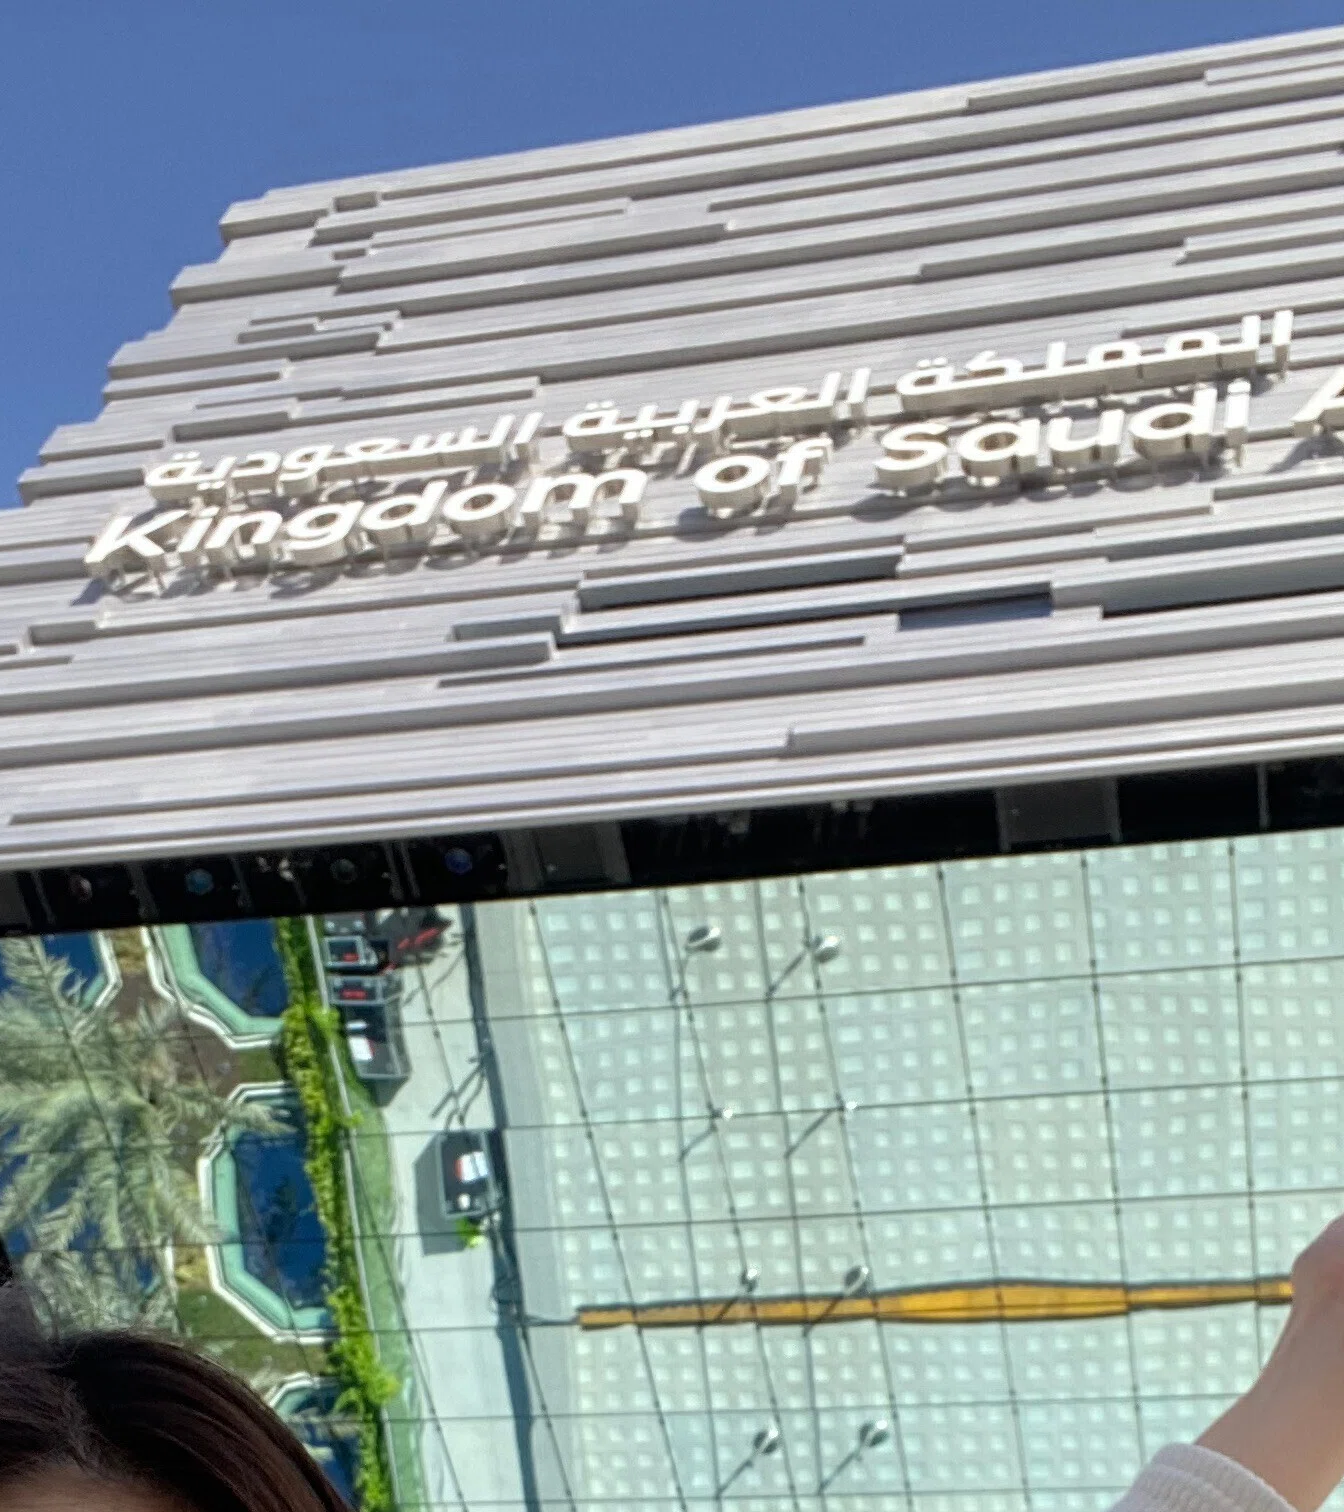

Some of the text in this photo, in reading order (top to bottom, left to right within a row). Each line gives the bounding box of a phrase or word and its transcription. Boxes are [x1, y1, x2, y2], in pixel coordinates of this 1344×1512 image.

[83, 466, 649, 567] Kingdom
[693, 437, 833, 497] of
[873, 379, 1253, 477] Saudi
[143, 309, 1295, 495] المملكة العربية السعودية
